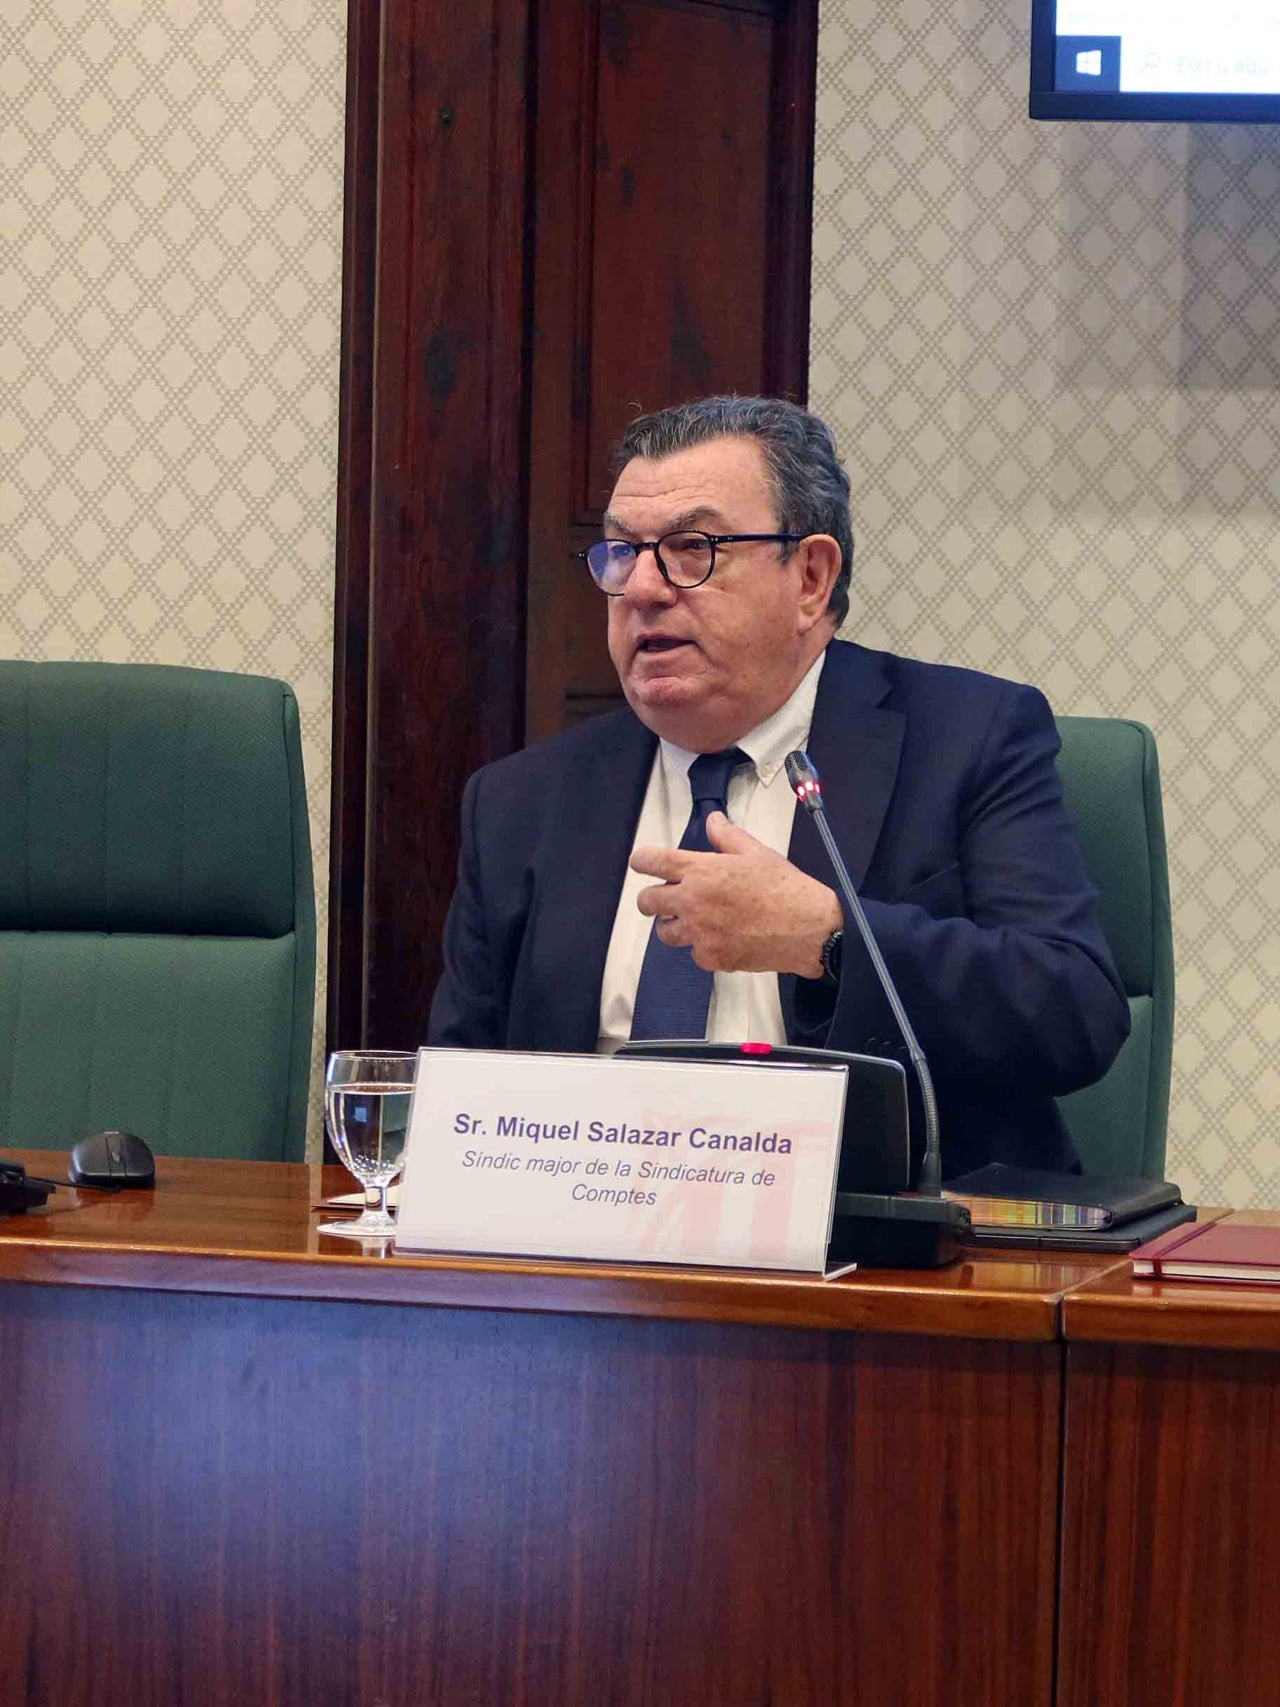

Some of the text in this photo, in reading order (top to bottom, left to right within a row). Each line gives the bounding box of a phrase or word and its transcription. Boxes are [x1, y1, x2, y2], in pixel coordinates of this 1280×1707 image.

[453, 1113, 793, 1155] Sr. Miquel Salazar Canalda
[462, 1150, 776, 1187] Síndic major de la Sindicatura de
[572, 1183, 658, 1208] Comptes
